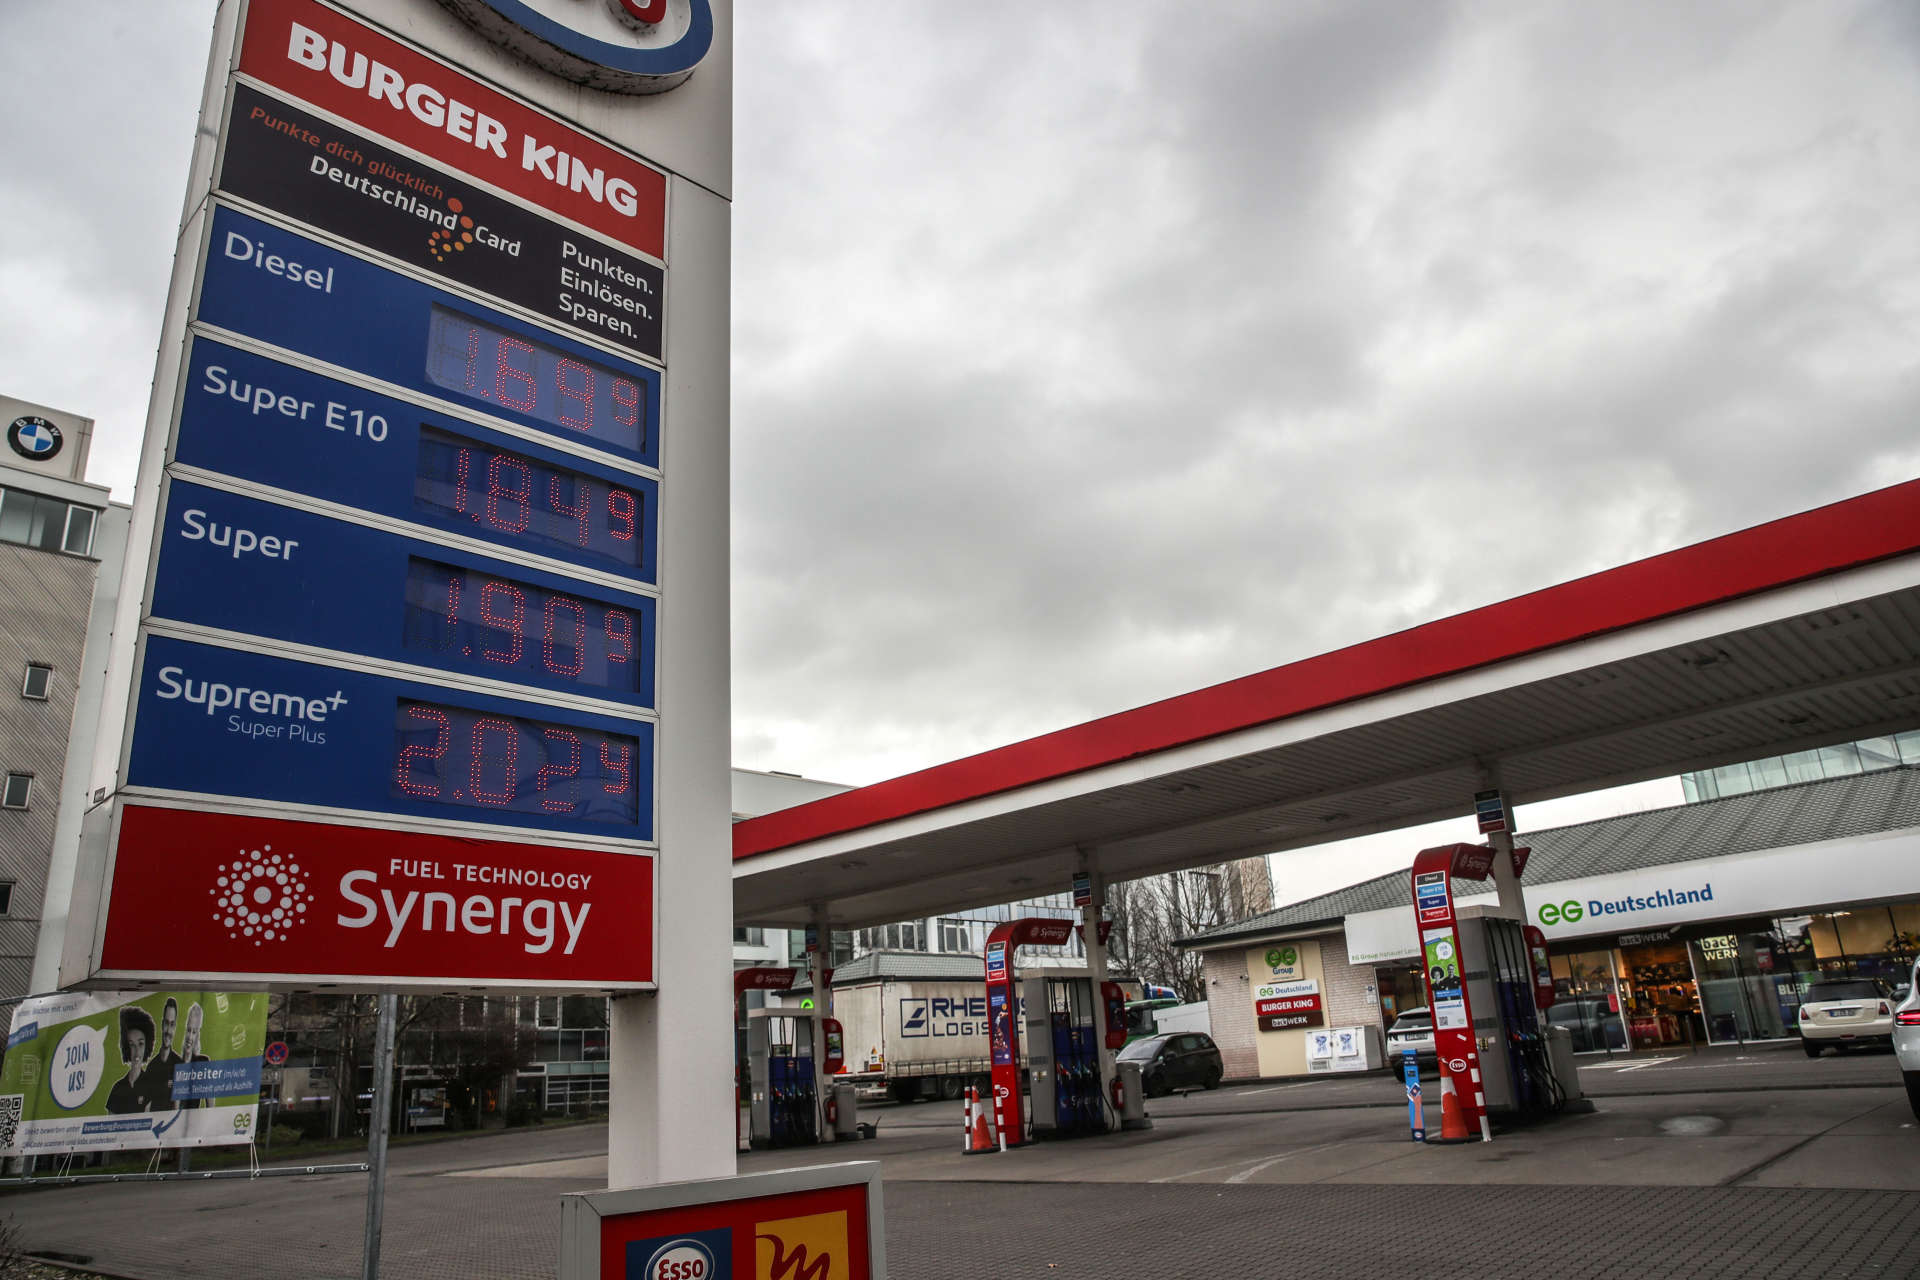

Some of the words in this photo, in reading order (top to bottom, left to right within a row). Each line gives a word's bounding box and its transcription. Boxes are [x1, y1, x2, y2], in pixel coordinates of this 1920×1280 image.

[287, 21, 507, 159] BURGER
[522, 133, 638, 217] KING
[250, 106, 320, 148] Punkte
[326, 140, 363, 167] dich
[368, 155, 444, 200] glücklich
[309, 155, 458, 231] Deutschland
[474, 226, 521, 258] Card
[224, 231, 335, 294] Diesel
[562, 241, 653, 295] Punkten.
[560, 268, 653, 320] Einlösen.
[559, 293, 638, 339] Sparen.
[203, 365, 316, 420] Super
[325, 404, 389, 443] E10
[15, 417, 61, 438] BMW
[180, 509, 299, 560] Super
[227, 714, 283, 743] Super
[288, 724, 326, 745] Plus
[389, 858, 445, 881] FUEL
[453, 864, 592, 891] TECHNOLOGY
[337, 870, 592, 955] Synergy
[1588, 883, 1713, 917] Deutschland
[1040, 927, 1066, 940] Synergy
[1701, 934, 1739, 951] back
[1704, 948, 1739, 960] WERK
[1272, 967, 1294, 975] Group
[1261, 1001, 1293, 1013] BURGER
[1293, 999, 1313, 1009] KING
[1275, 984, 1313, 995] Deutschland
[64, 1041, 89, 1069] JOIN
[68, 1070, 86, 1092] US!
[657, 1257, 704, 1280] Esso
